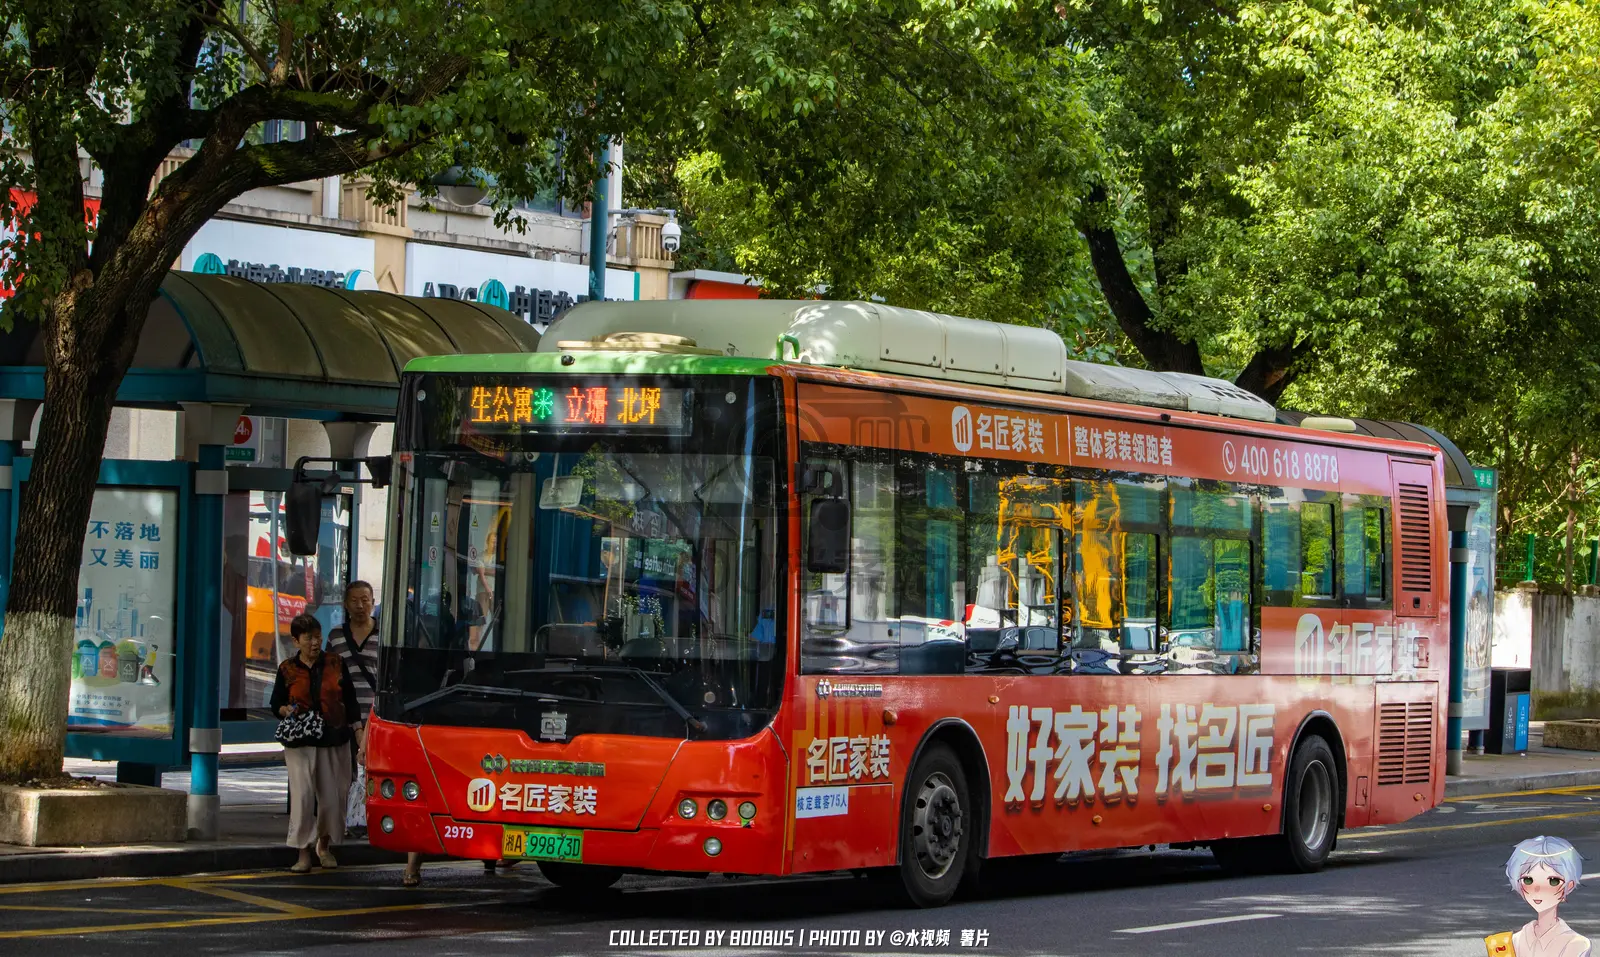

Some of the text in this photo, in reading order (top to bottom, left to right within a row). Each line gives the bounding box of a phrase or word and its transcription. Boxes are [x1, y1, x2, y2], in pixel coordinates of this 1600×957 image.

[471, 386, 661, 424] 生公寓 立珊 北坪
[976, 413, 1044, 455] 名匠家装
[1074, 425, 1173, 466] 整体家装领跑者
[1241, 444, 1339, 484] 400 618 8878
[89, 520, 161, 542] 不落地
[88, 548, 160, 570] 又美丽
[806, 734, 891, 783] 名匠家装
[1004, 702, 1275, 804] 好家装 找名匠
[499, 782, 598, 816] 名匠家装
[797, 793, 847, 811] 核定载客75人
[444, 825, 474, 840] 2979
